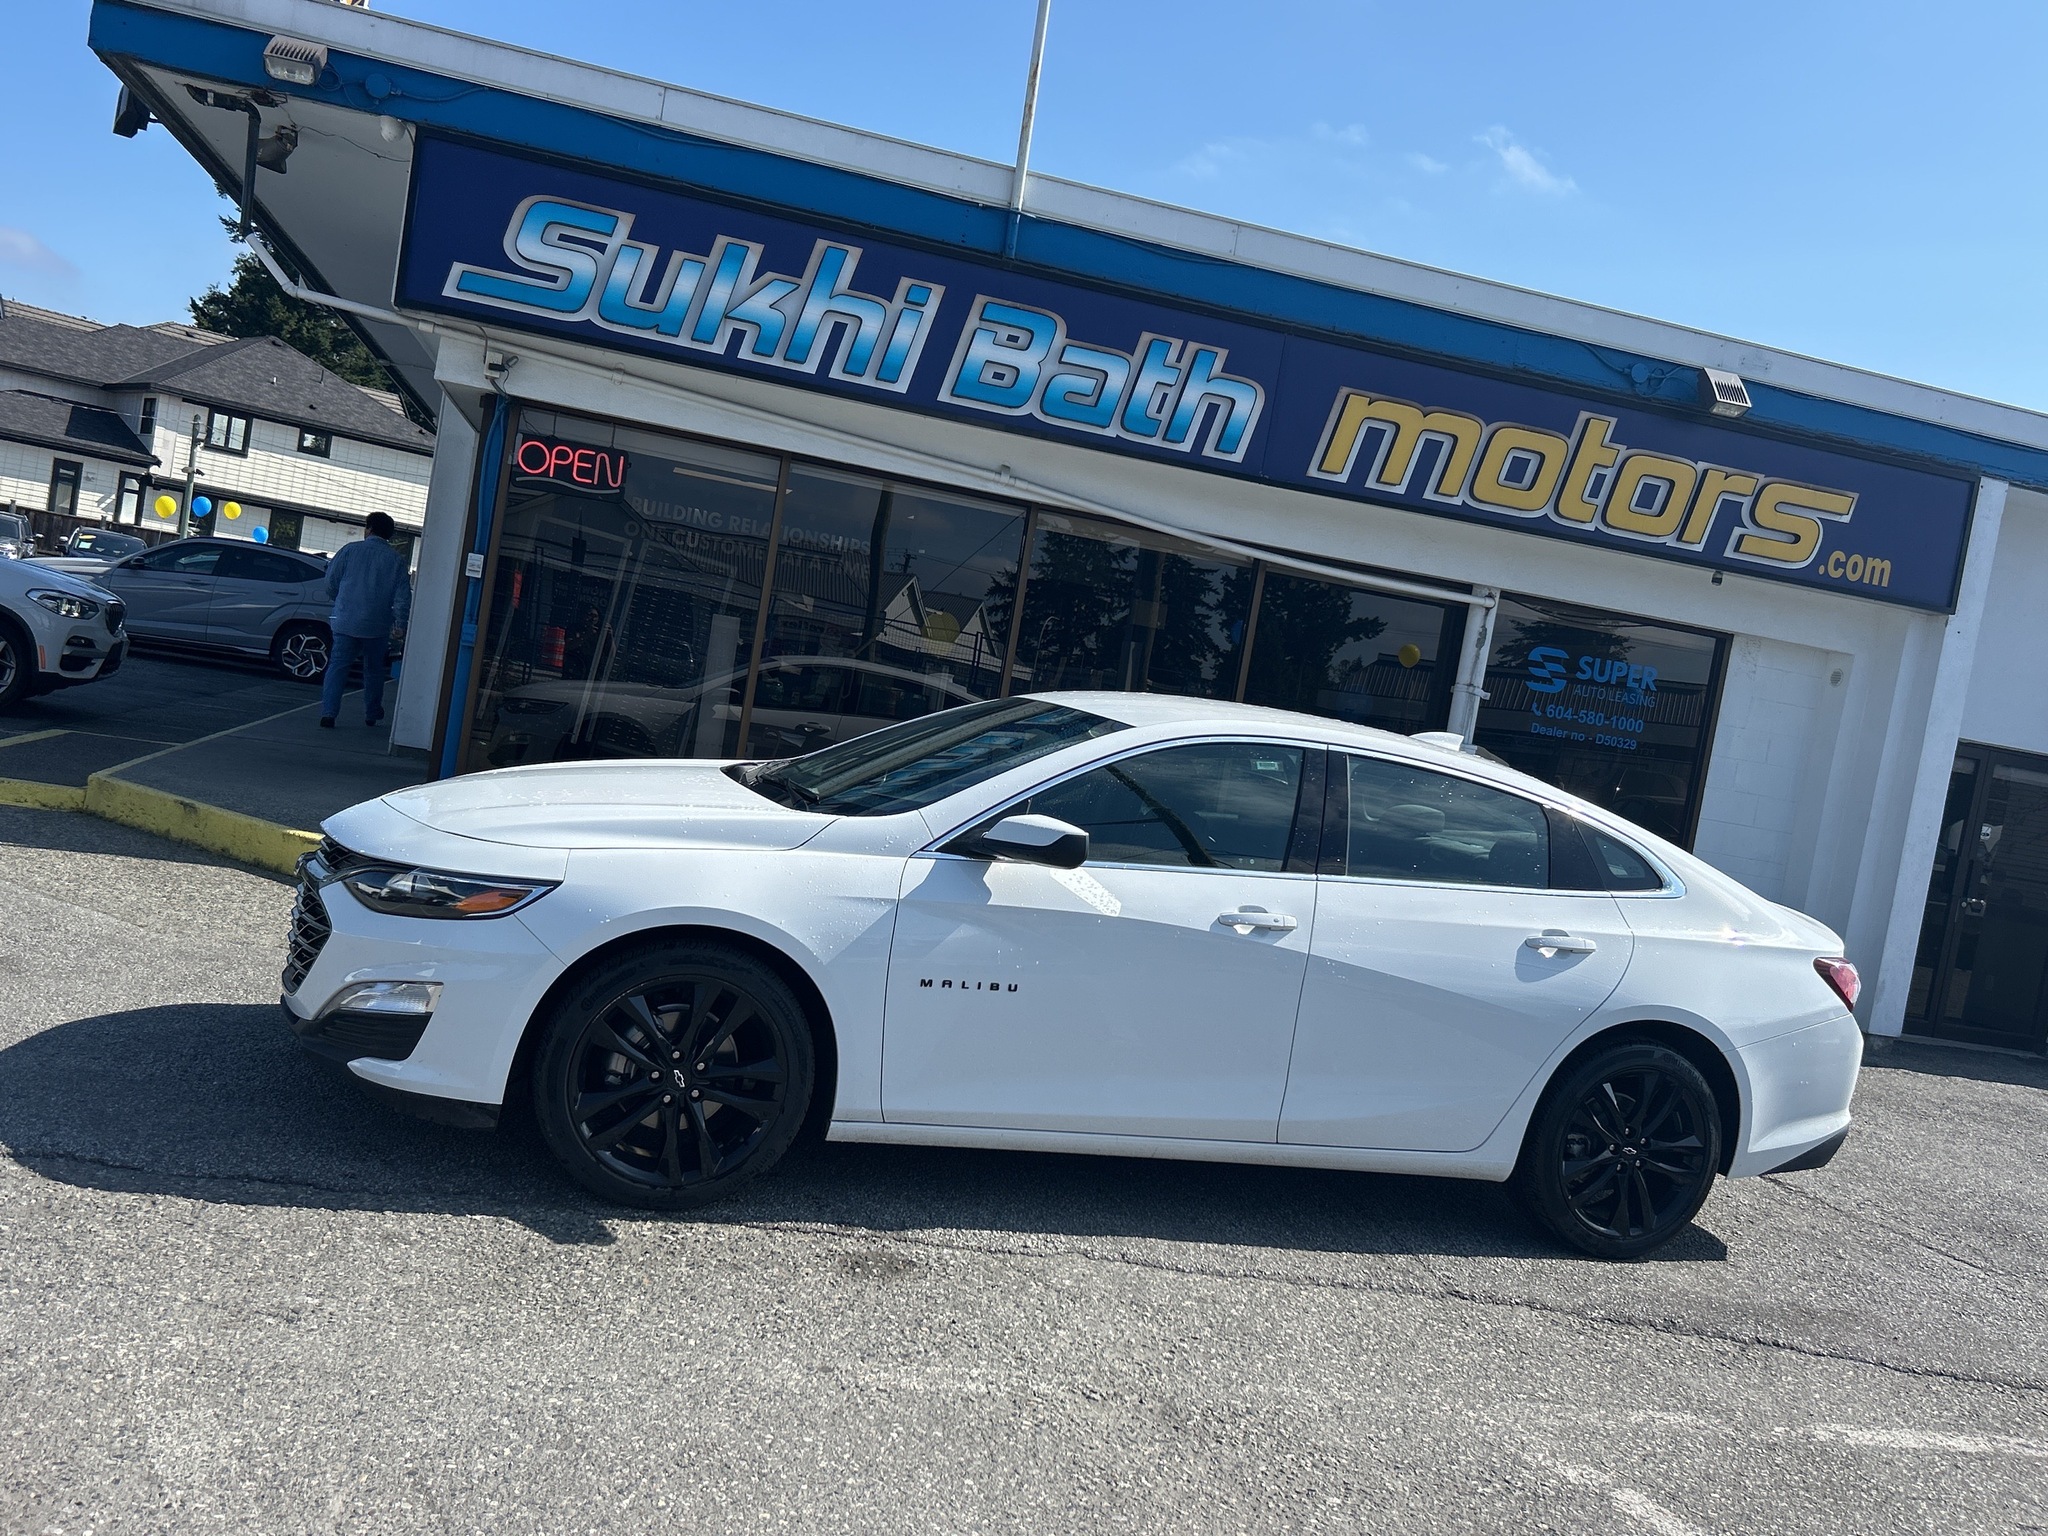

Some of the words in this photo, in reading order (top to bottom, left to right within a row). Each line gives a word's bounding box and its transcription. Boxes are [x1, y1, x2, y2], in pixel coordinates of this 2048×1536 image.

[442, 195, 945, 394] Sukhi
[938, 293, 1266, 464] Bath
[1306, 385, 1858, 570] motors
[1818, 549, 1892, 588] .com
[517, 439, 625, 488] OPEN
[623, 520, 664, 543] ONE
[671, 528, 768, 561] CUSTOME
[631, 496, 724, 529] BUILDING
[728, 514, 871, 555] RELAIONSHIPS
[1575, 655, 1659, 692] SUPER
[1573, 685, 1606, 700] AUTO
[1608, 688, 1656, 708] LEASING
[1530, 722, 1568, 739] Dealer
[1570, 732, 1585, 742] no
[1595, 734, 1637, 750] D50329
[1546, 704, 1644, 734] 604-580-1000
[920, 978, 1018, 992] MALIBU
